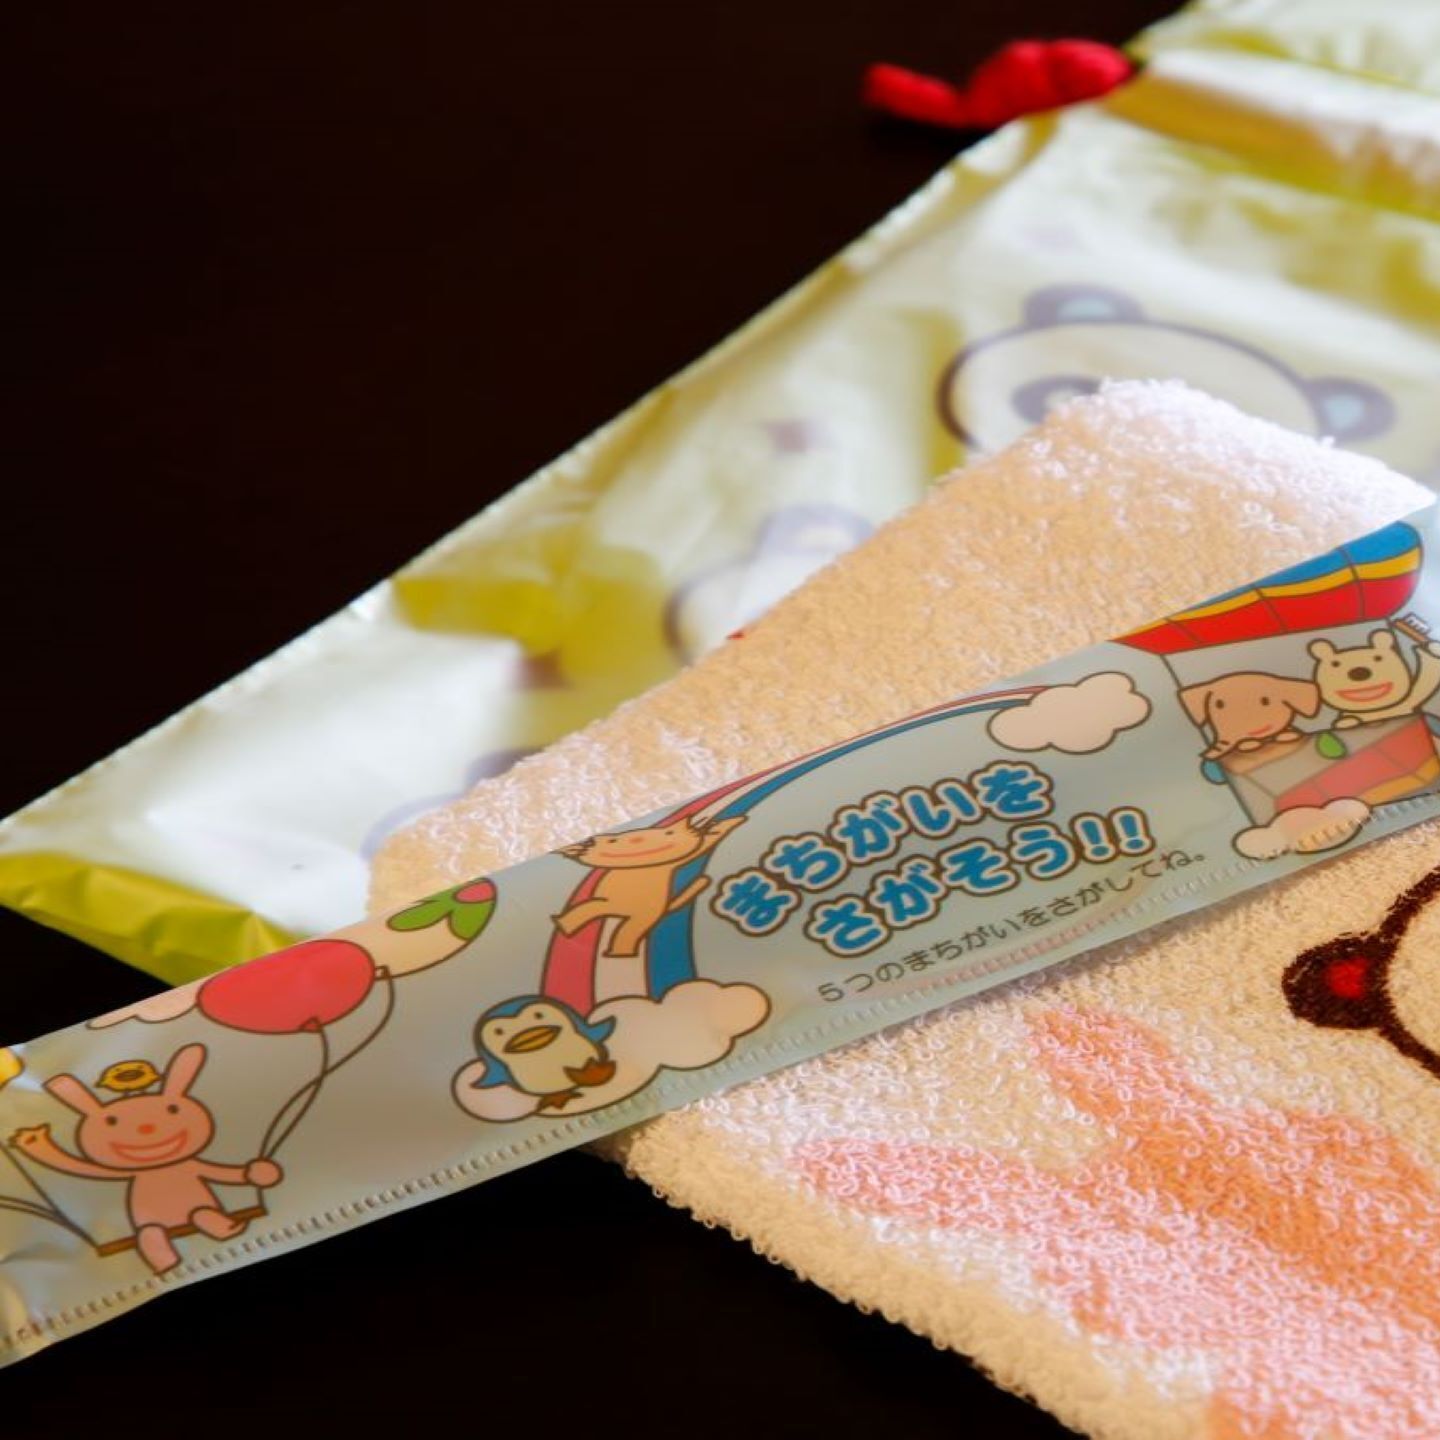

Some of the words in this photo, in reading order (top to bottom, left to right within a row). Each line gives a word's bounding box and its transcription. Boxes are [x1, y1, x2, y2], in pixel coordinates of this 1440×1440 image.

[711, 761, 1054, 936] まちがいを
